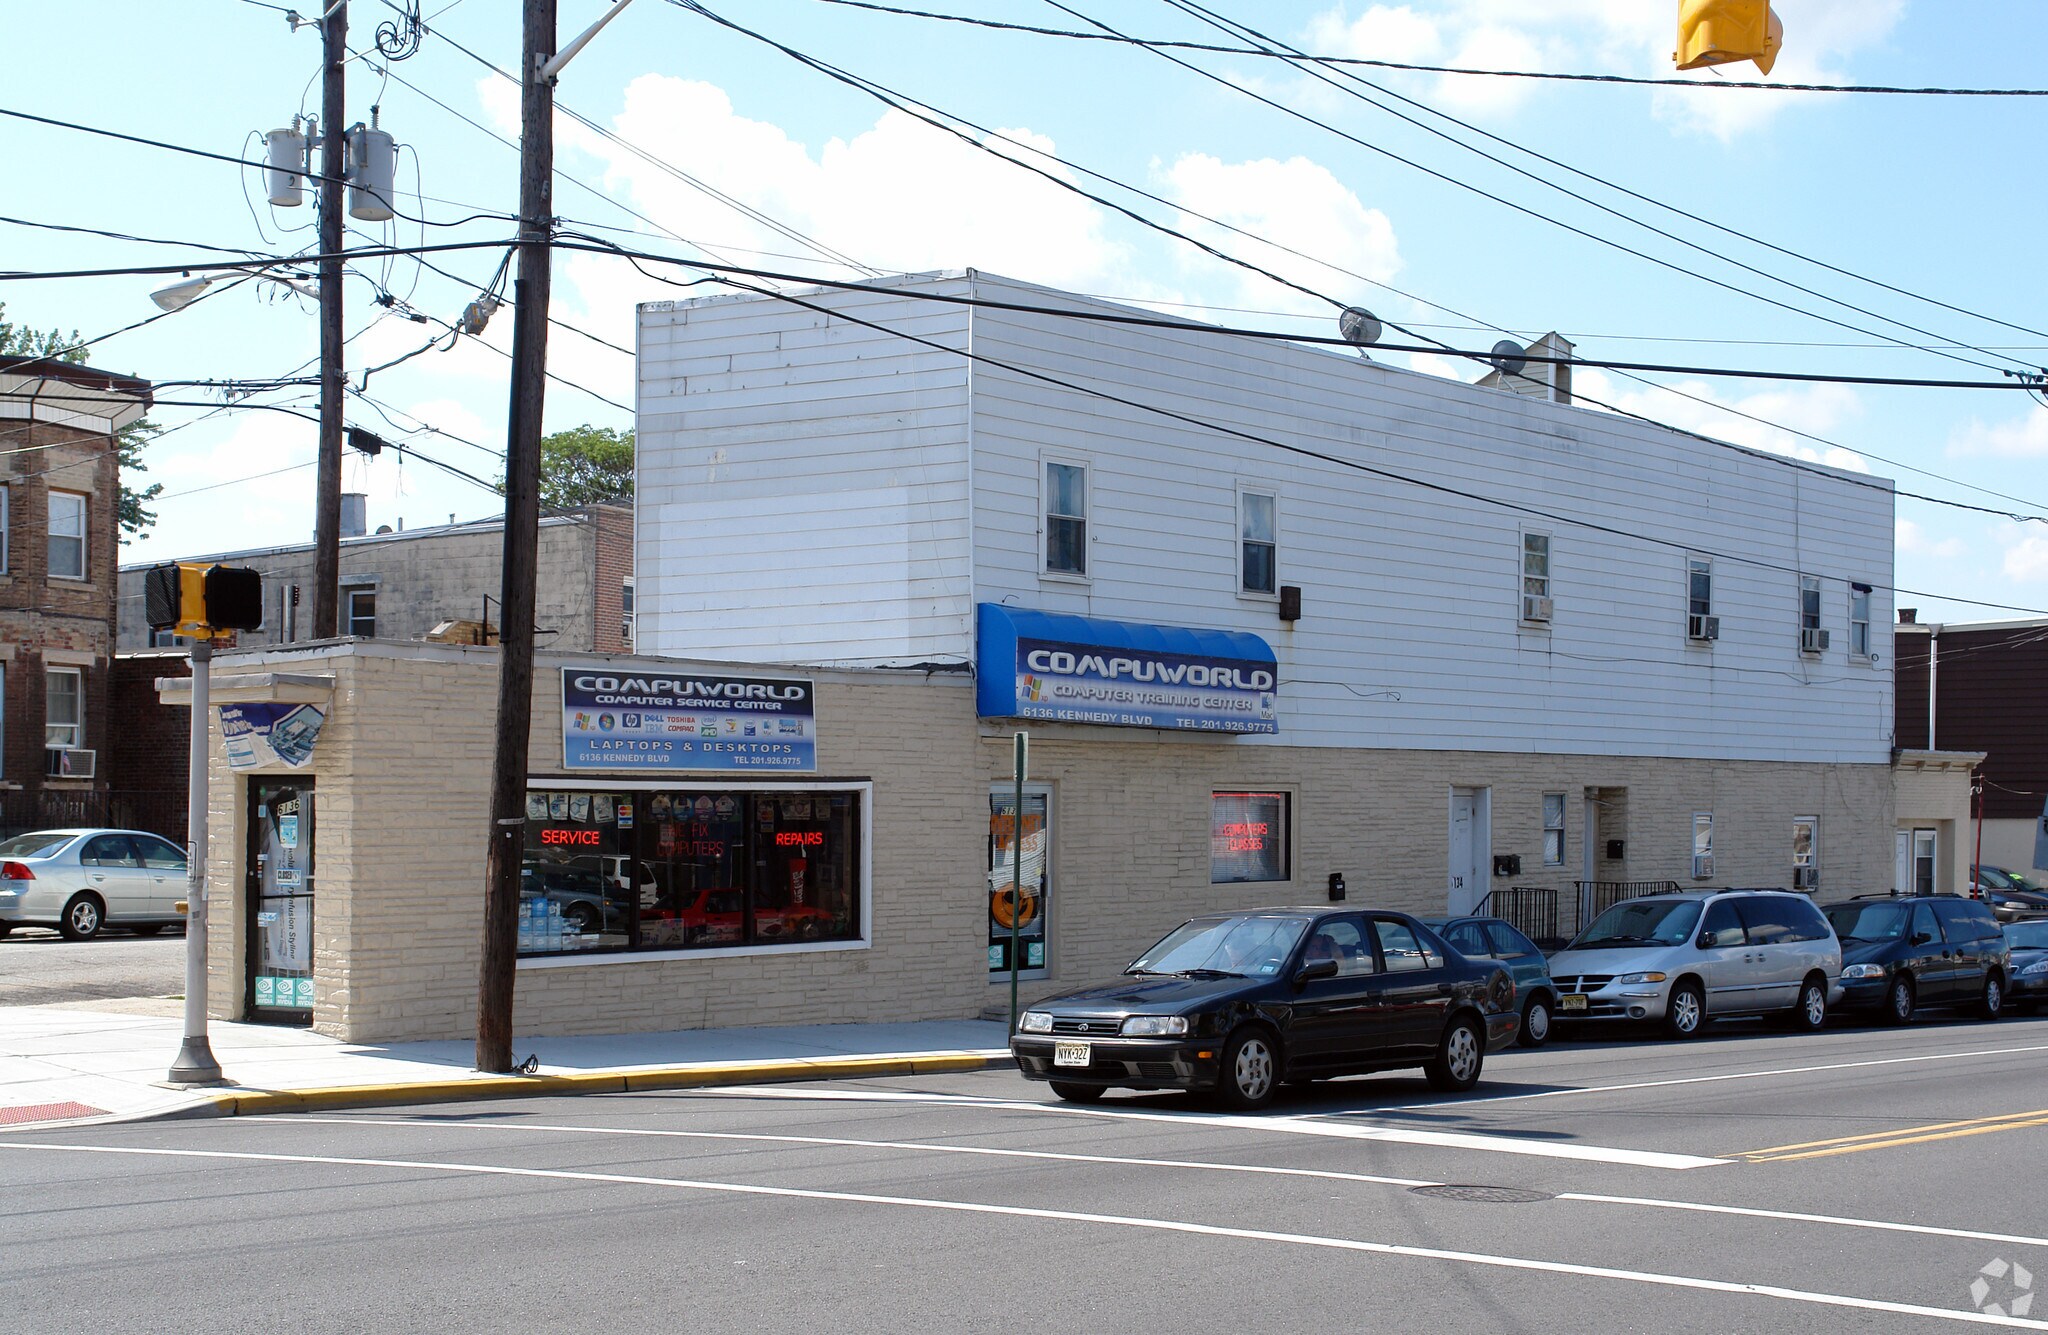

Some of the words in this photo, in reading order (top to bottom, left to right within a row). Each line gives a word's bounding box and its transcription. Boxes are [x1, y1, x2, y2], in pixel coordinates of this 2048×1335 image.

[1027, 650, 1273, 691] COMPUWORLD
[574, 676, 805, 700] COMPUWORLD
[595, 694, 674, 707] COMPUTER
[676, 698, 731, 709] SERVICE
[734, 700, 782, 711] CENTER
[1053, 685, 1134, 701] COMPUTER
[1203, 697, 1252, 710] CENTER
[644, 714, 664, 723] DELL
[667, 716, 696, 724] TOSHIBA
[1023, 707, 1053, 718] 6136
[1057, 710, 1118, 723] KENNEDY
[1121, 714, 1152, 726] BLVD
[645, 724, 663, 733] IBM
[1176, 718, 1198, 729] TEL
[1201, 720, 1273, 733] 201.926.9775
[590, 740, 673, 751] LAPTOPS
[683, 742, 693, 751] &
[703, 743, 792, 754] DESKTOPS
[579, 753, 601, 762] 6136
[603, 753, 644, 762] KENNEDY
[647, 755, 670, 763] BLVD
[734, 756, 749, 764] TEL
[751, 756, 801, 765] 201.926.9775
[278, 799, 300, 815] 6136
[1001, 807, 1016, 815] 613
[541, 829, 600, 845] SERVICE
[775, 832, 823, 846] REPAIRS
